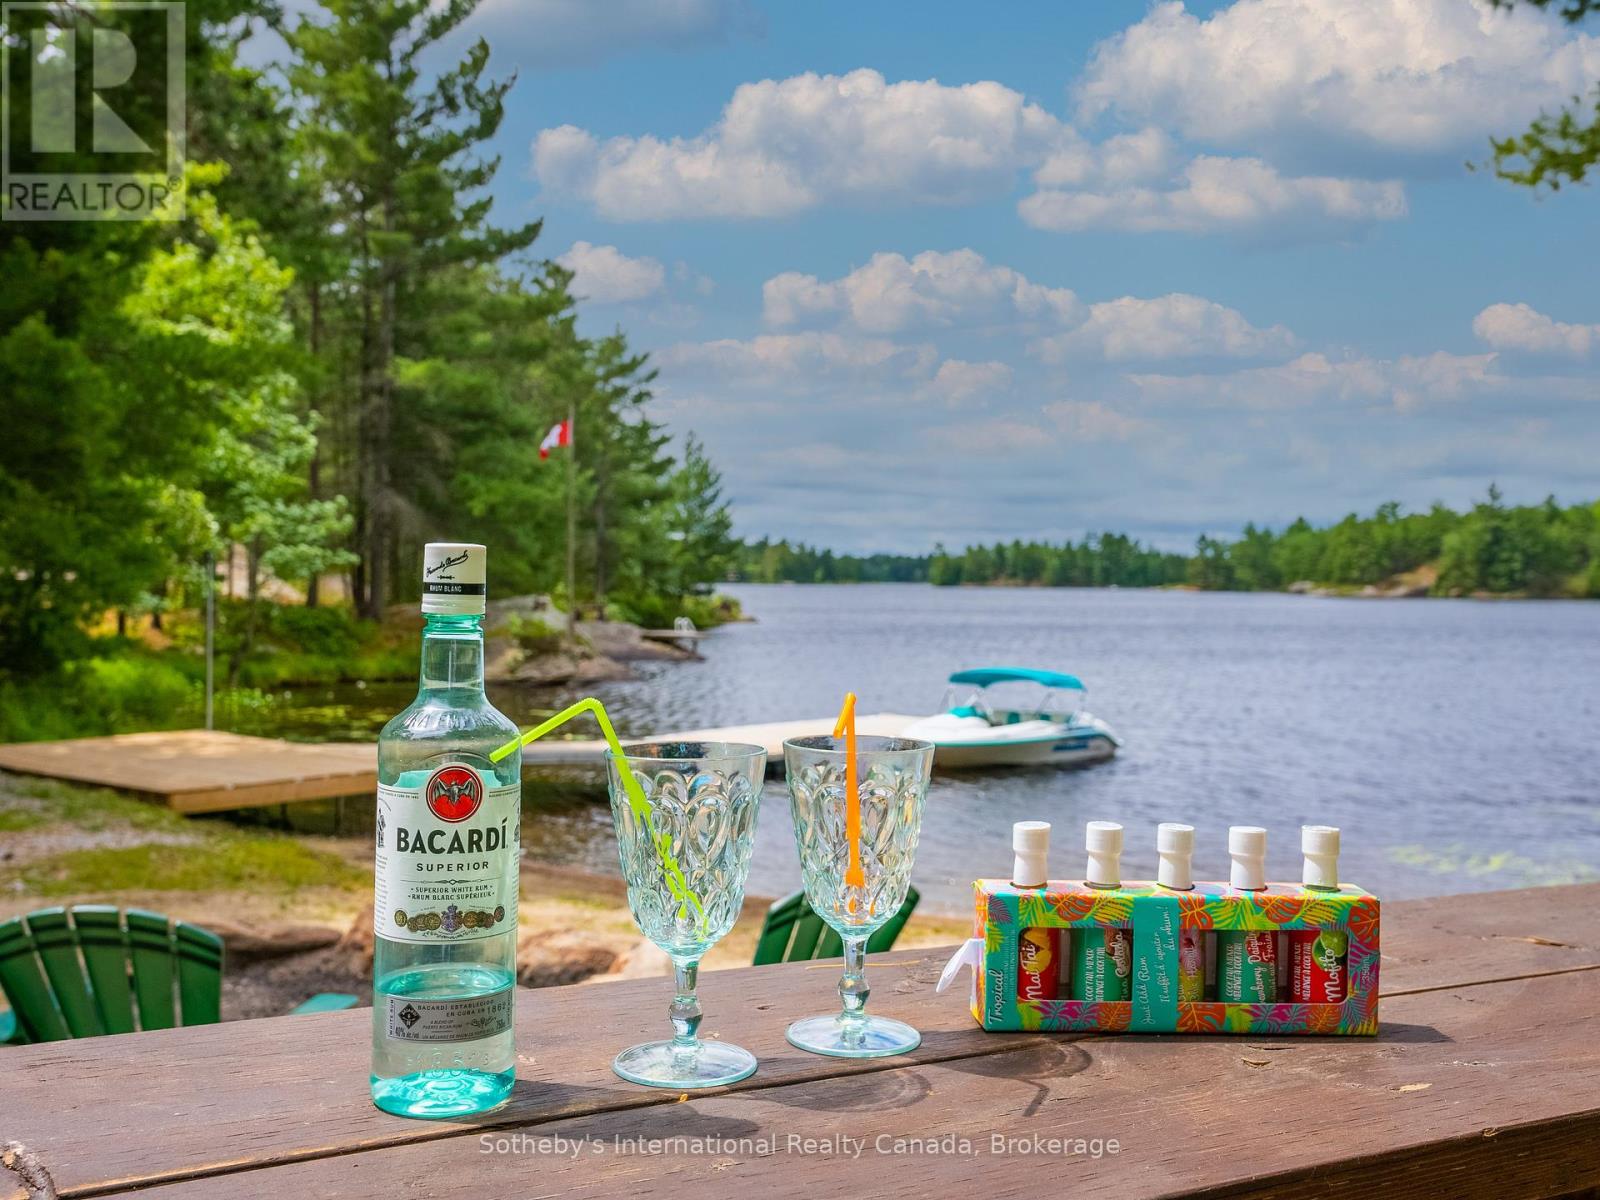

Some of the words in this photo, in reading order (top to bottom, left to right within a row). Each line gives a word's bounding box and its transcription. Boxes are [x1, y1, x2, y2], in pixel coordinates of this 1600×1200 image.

[444, 585, 462, 593] BLANC
[396, 817, 508, 855] BACARDÍ
[416, 861, 489, 872] SUPERIOR
[411, 893, 430, 901] RHUM
[415, 886, 449, 894] SUPERIOR
[475, 884, 489, 892] RUM
[1019, 943, 1040, 969] Tai
[1109, 931, 1129, 978] Colada
[1163, 937, 1175, 951] du
[1085, 948, 1094, 970] MIXER
[1096, 946, 1106, 974] COCKTAIL
[1137, 956, 1151, 982] Rum
[1024, 970, 1043, 1001] Mai
[1085, 971, 1094, 1001] COCKTAIL
[1318, 948, 1342, 1002] Mojito
[988, 968, 1005, 1025] Tropical
[1136, 983, 1149, 1004] Add
[1141, 1005, 1155, 1025] Just
